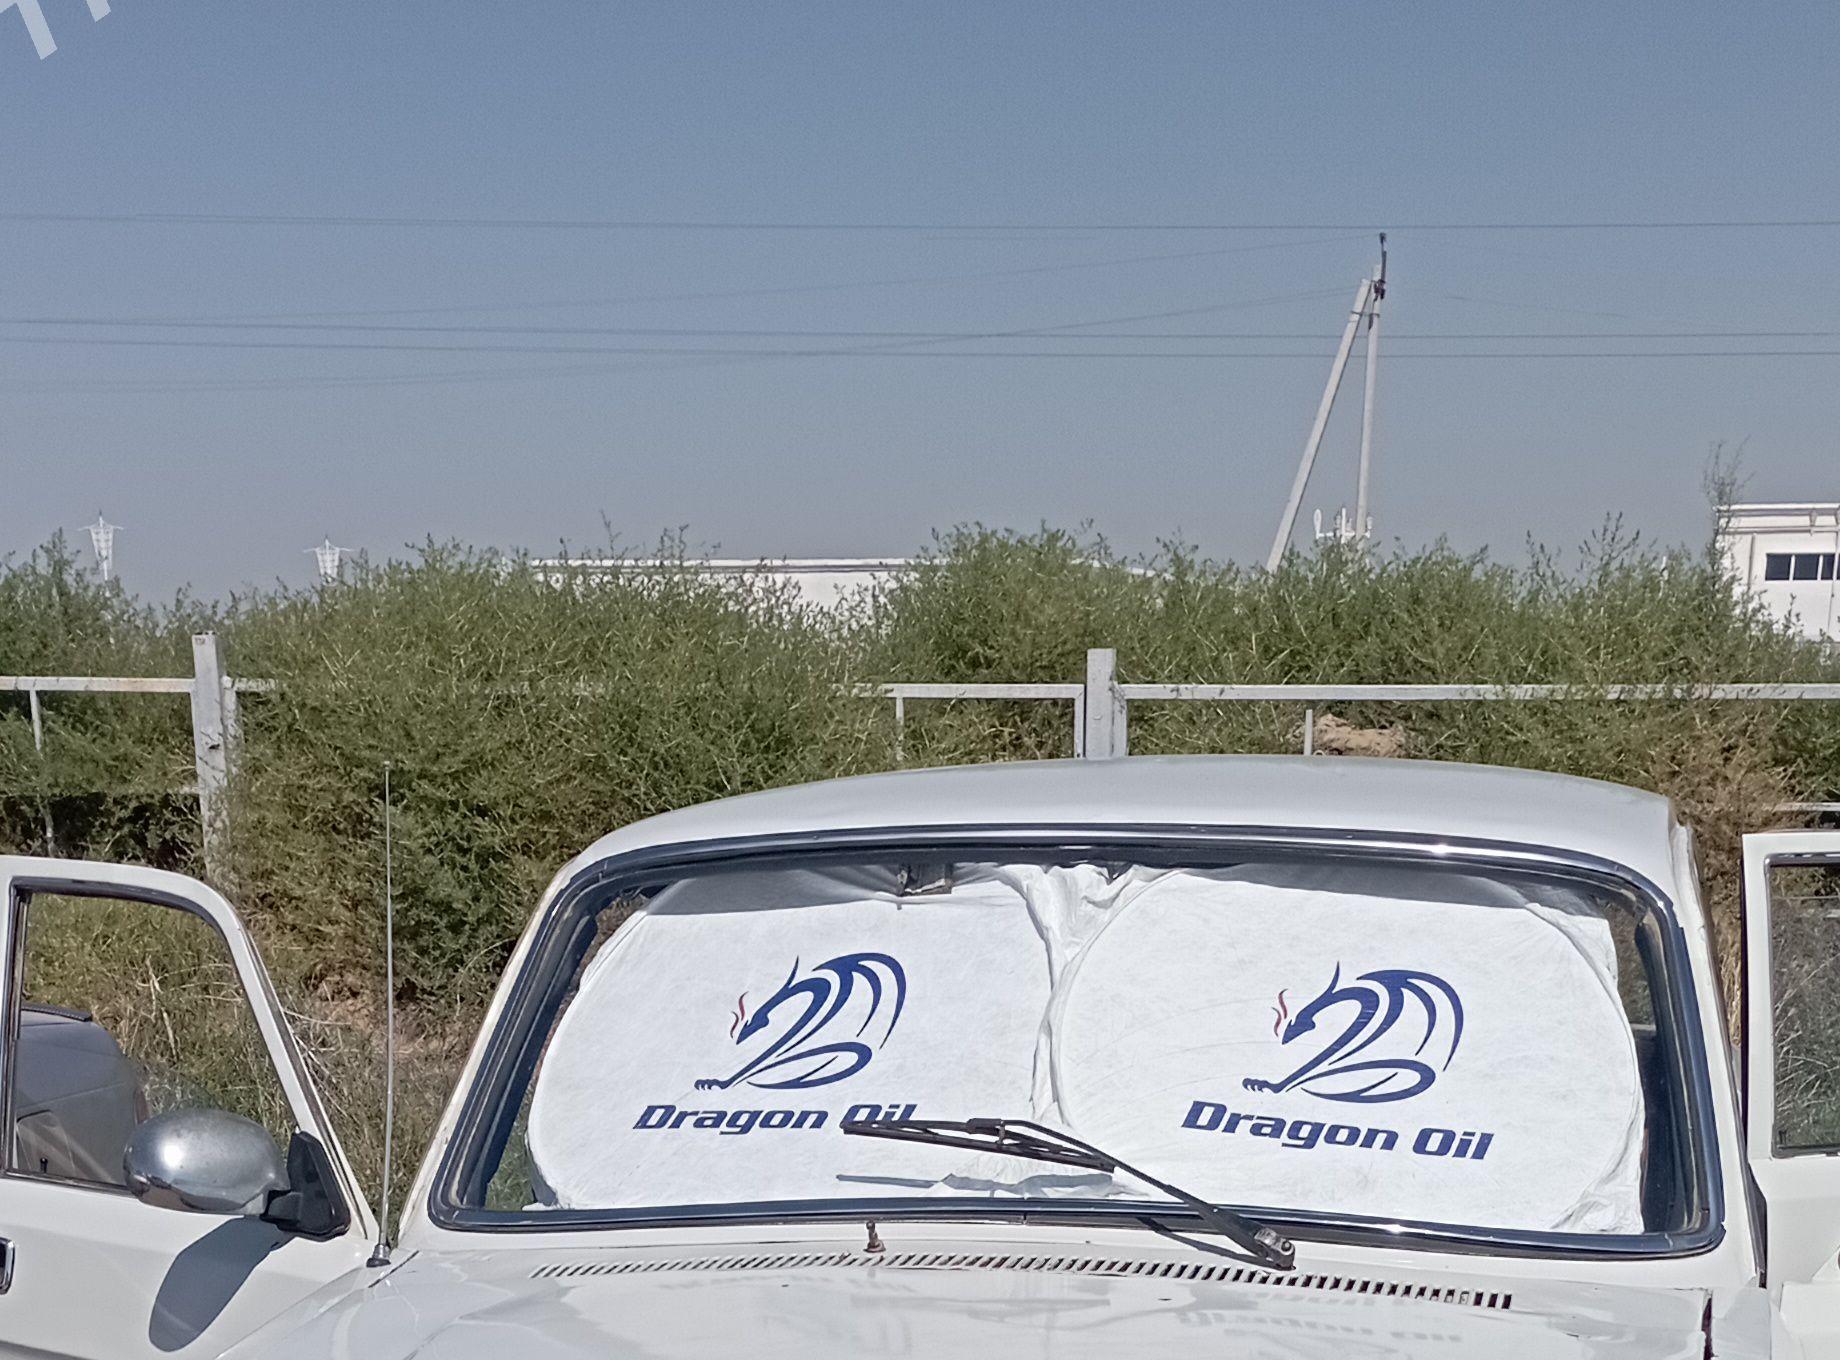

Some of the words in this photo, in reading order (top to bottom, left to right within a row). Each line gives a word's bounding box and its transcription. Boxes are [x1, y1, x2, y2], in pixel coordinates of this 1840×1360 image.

[633, 1104, 829, 1136] Dragon
[1181, 1100, 1400, 1151] Dragon
[1412, 1127, 1495, 1161] Oil
